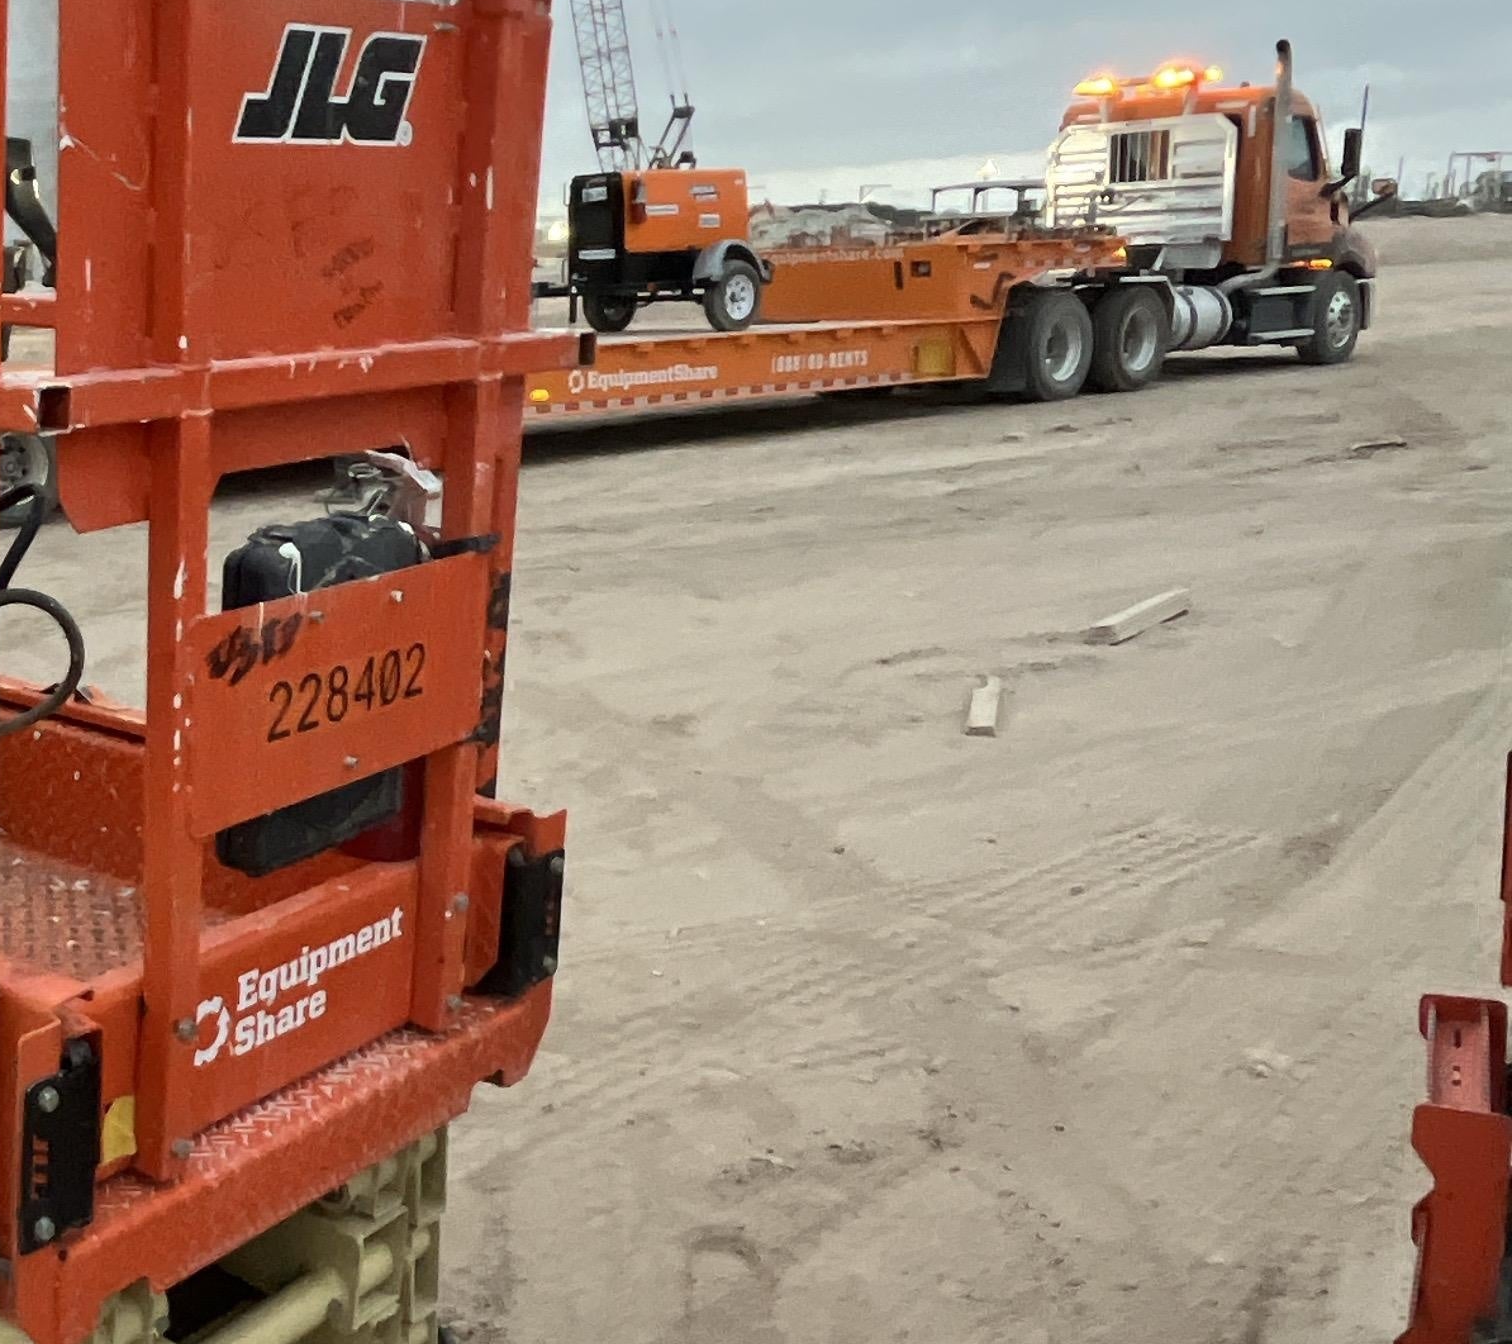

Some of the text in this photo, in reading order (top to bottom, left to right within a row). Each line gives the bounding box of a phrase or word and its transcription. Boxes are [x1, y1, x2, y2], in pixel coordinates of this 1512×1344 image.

[232, 23, 428, 146] JLG
[587, 363, 718, 391] EquipmentShare
[267, 643, 426, 743] 228402
[236, 906, 404, 1012] Equipment
[234, 989, 327, 1056] Share
